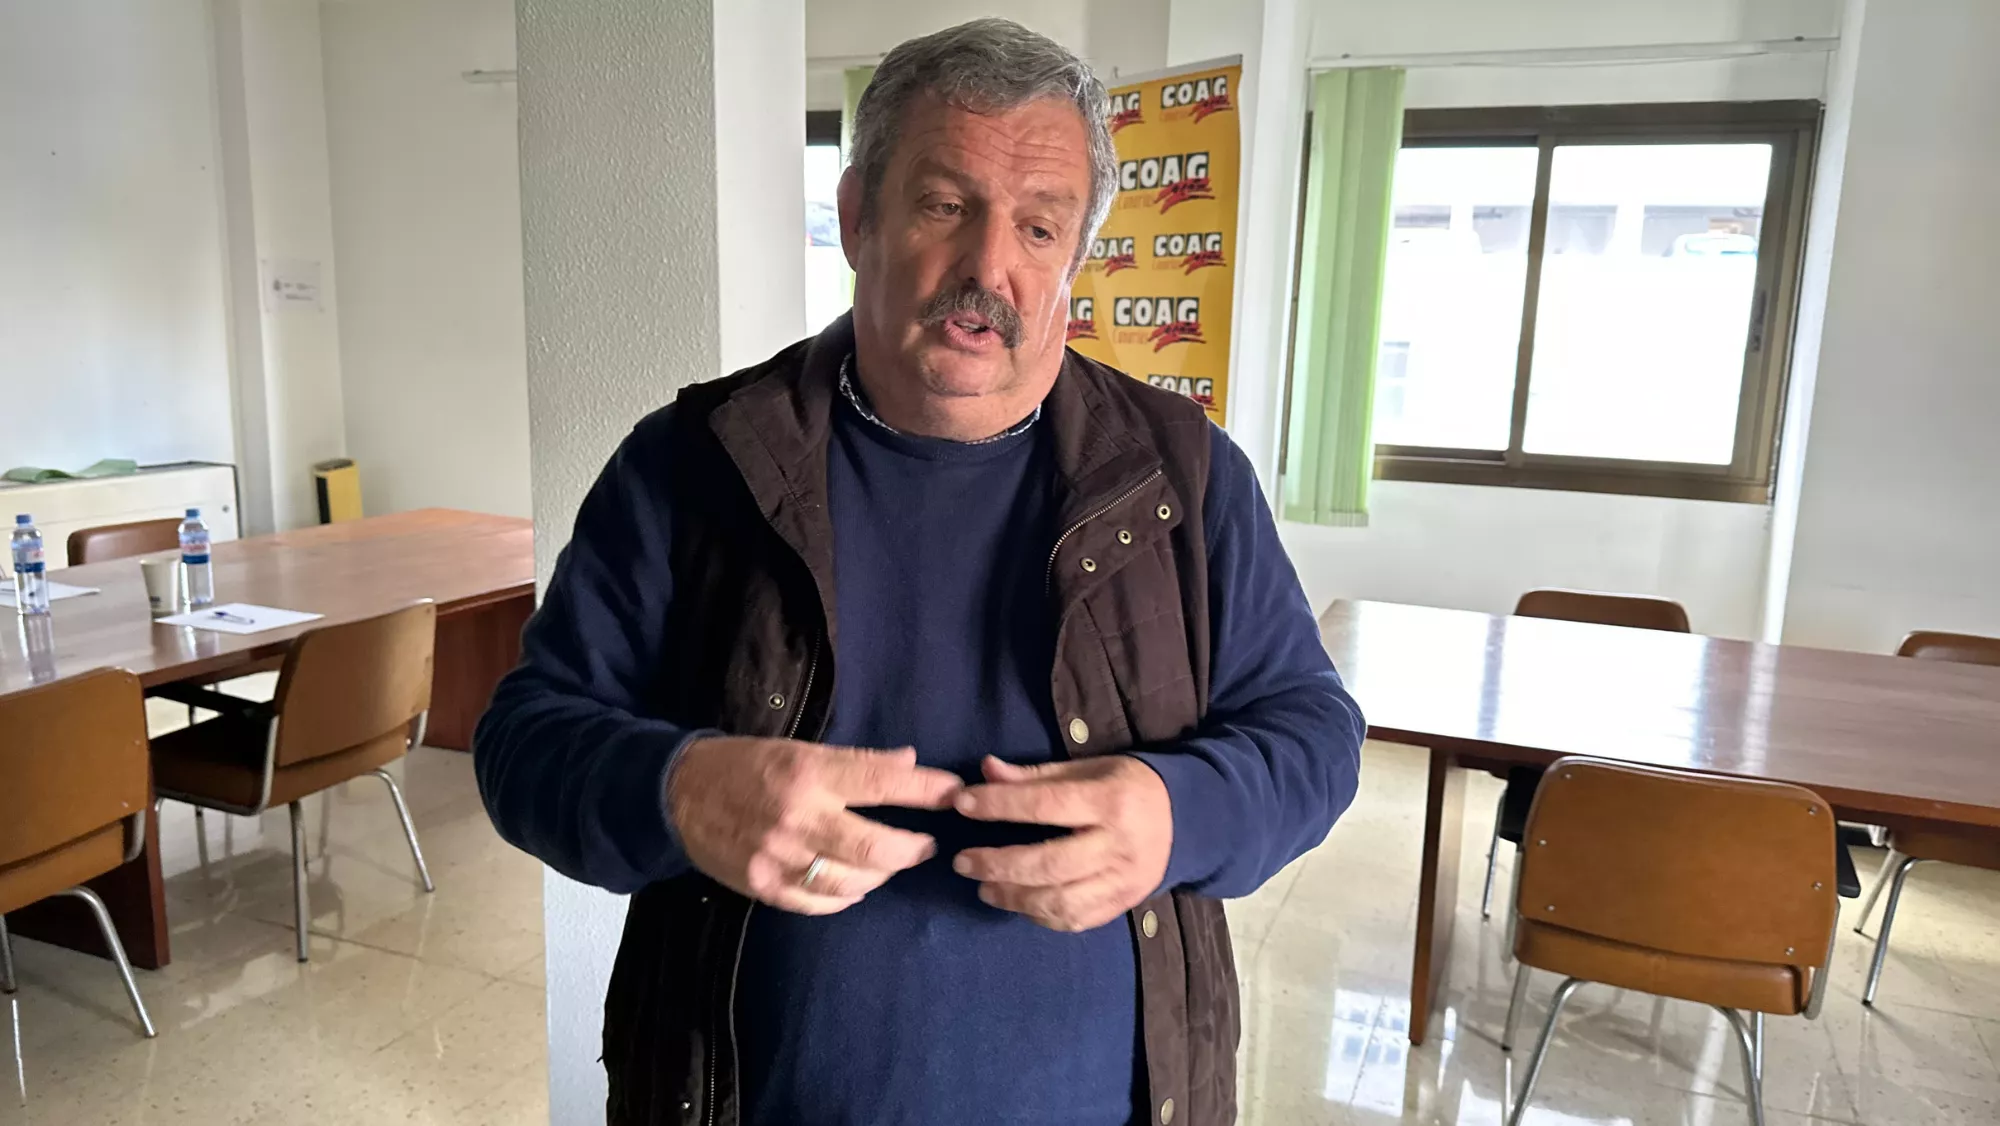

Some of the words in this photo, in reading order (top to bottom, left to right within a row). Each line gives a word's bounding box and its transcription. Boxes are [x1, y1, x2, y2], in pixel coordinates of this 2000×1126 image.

[1109, 91, 1141, 117] AG
[1161, 75, 1228, 109] COAG
[1120, 152, 1209, 191] COAG
[1090, 236, 1134, 260] OAG
[1154, 232, 1222, 257] COAG
[1113, 297, 1200, 326] COAG
